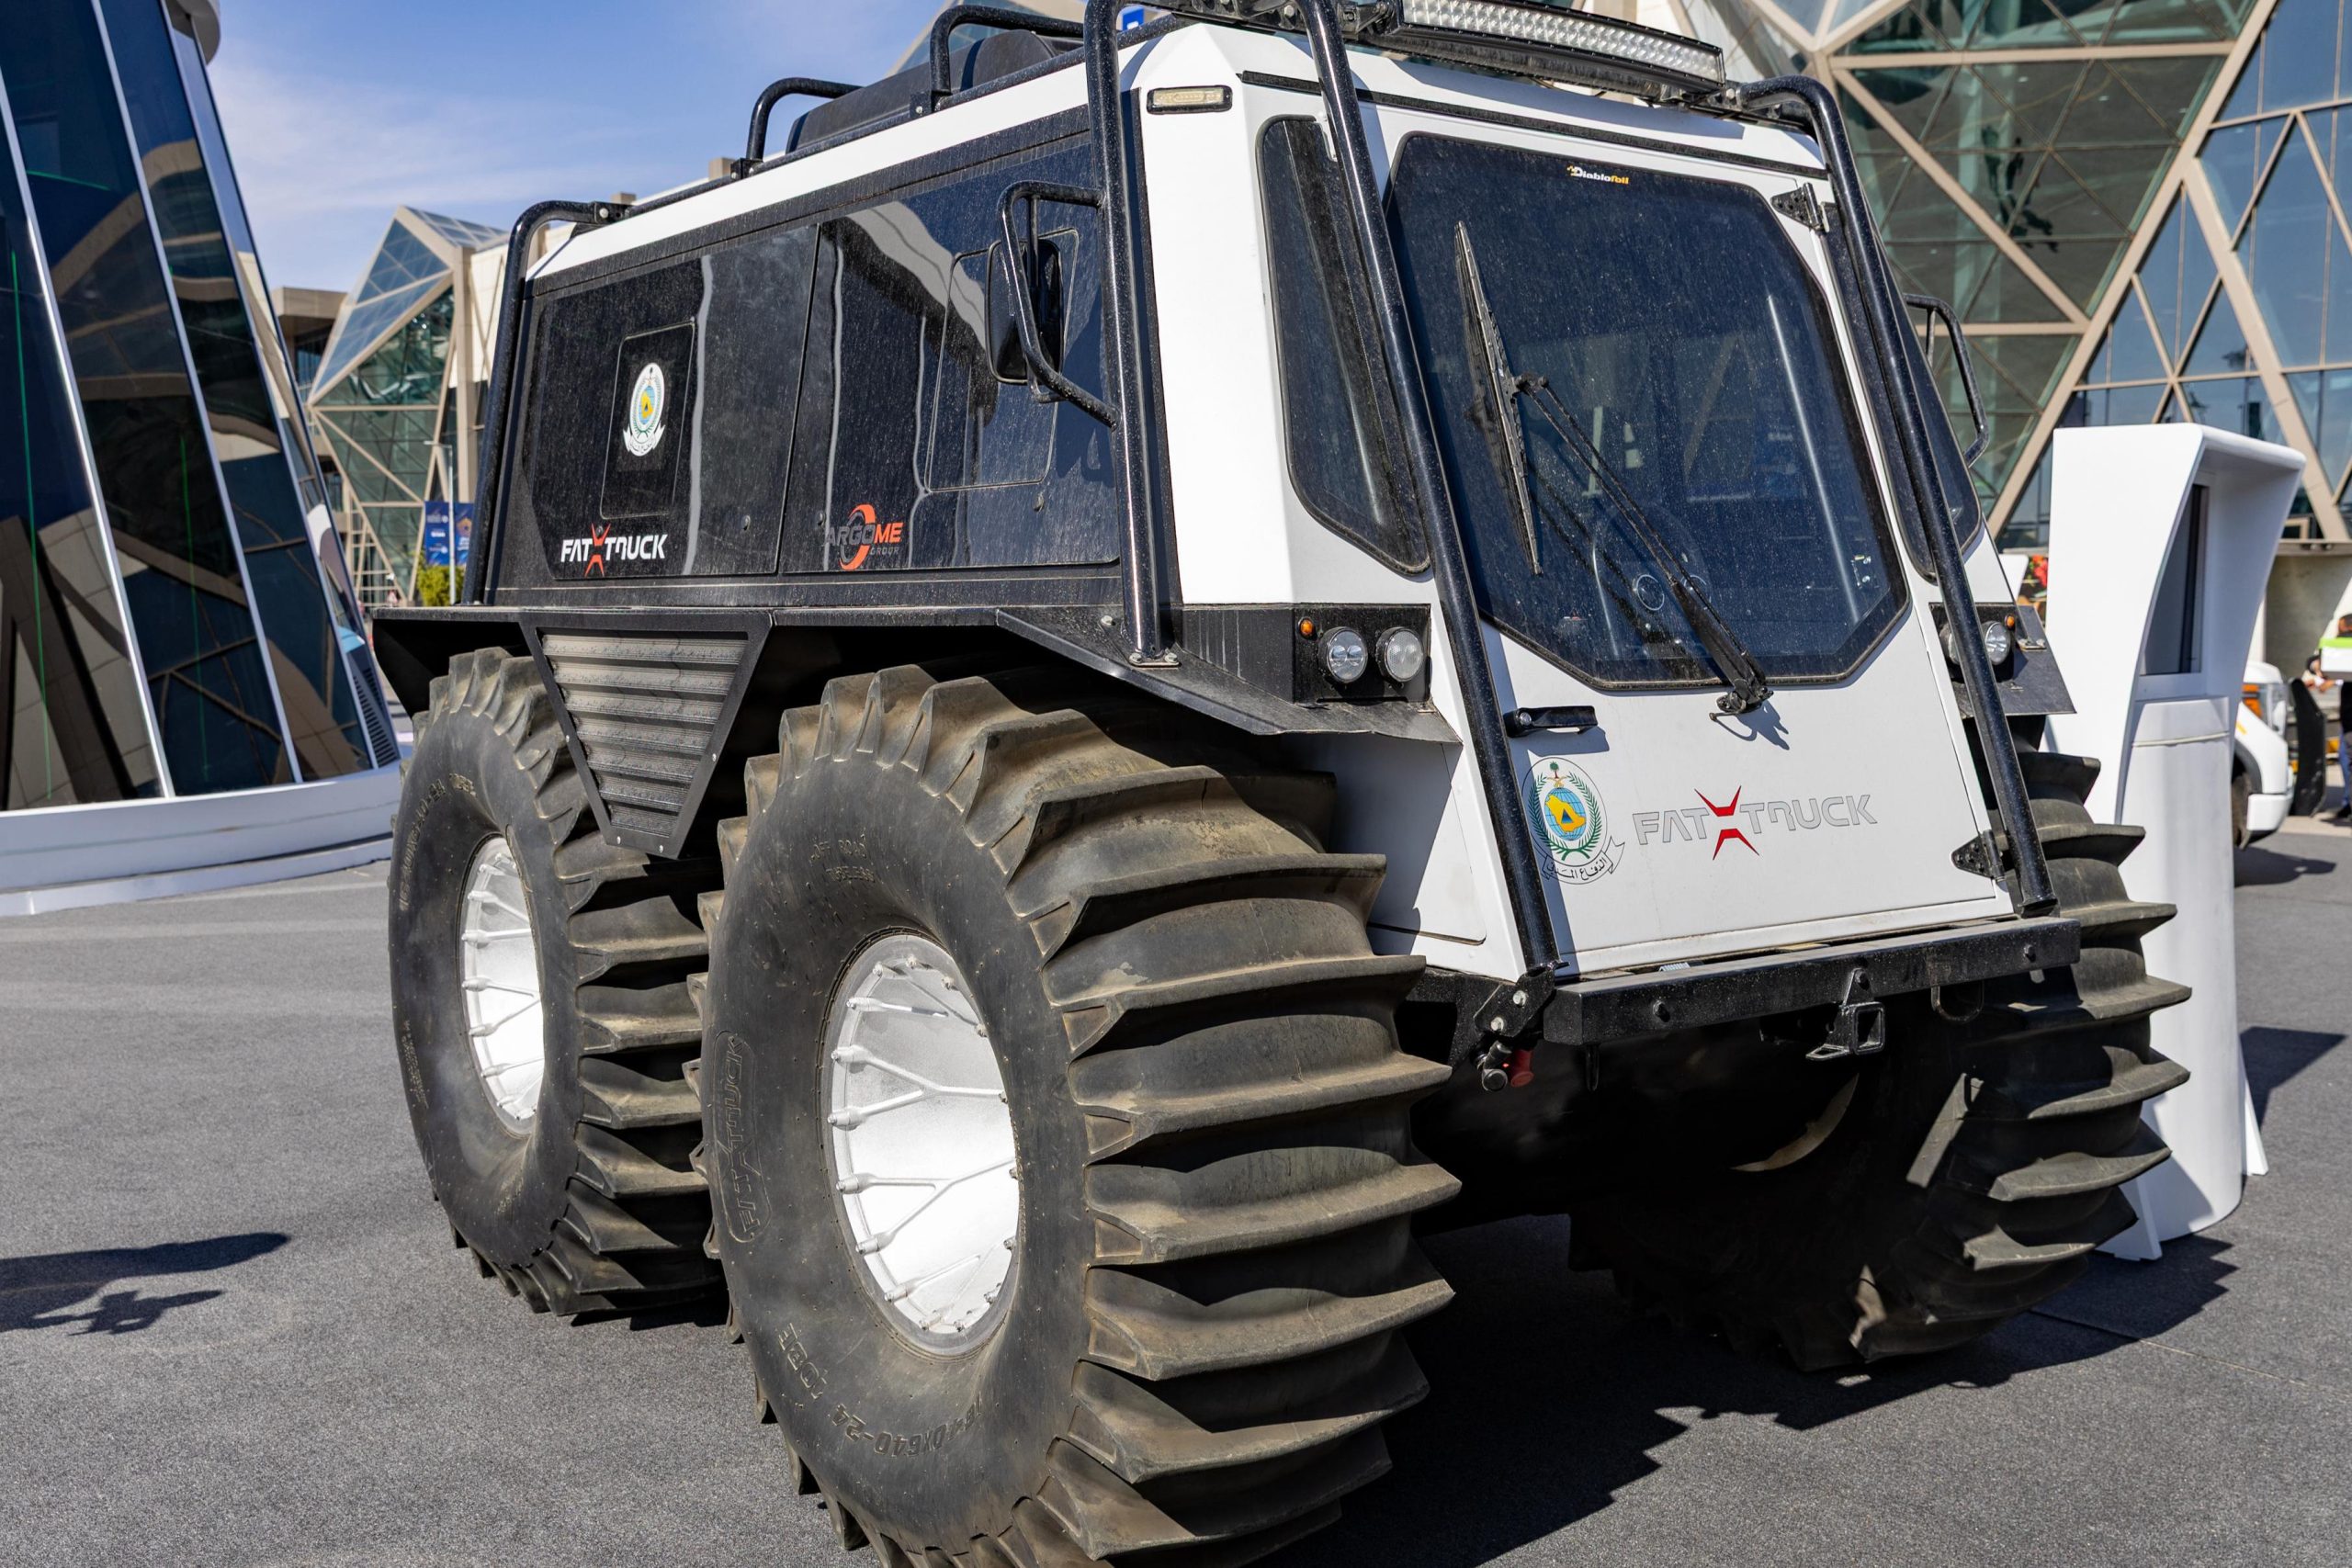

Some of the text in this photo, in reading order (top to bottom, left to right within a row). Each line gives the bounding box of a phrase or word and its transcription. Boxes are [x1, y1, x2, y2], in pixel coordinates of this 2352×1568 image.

[560, 534, 668, 563] FAT TRUCK
[1632, 795, 1878, 845] FAT TRUCK
